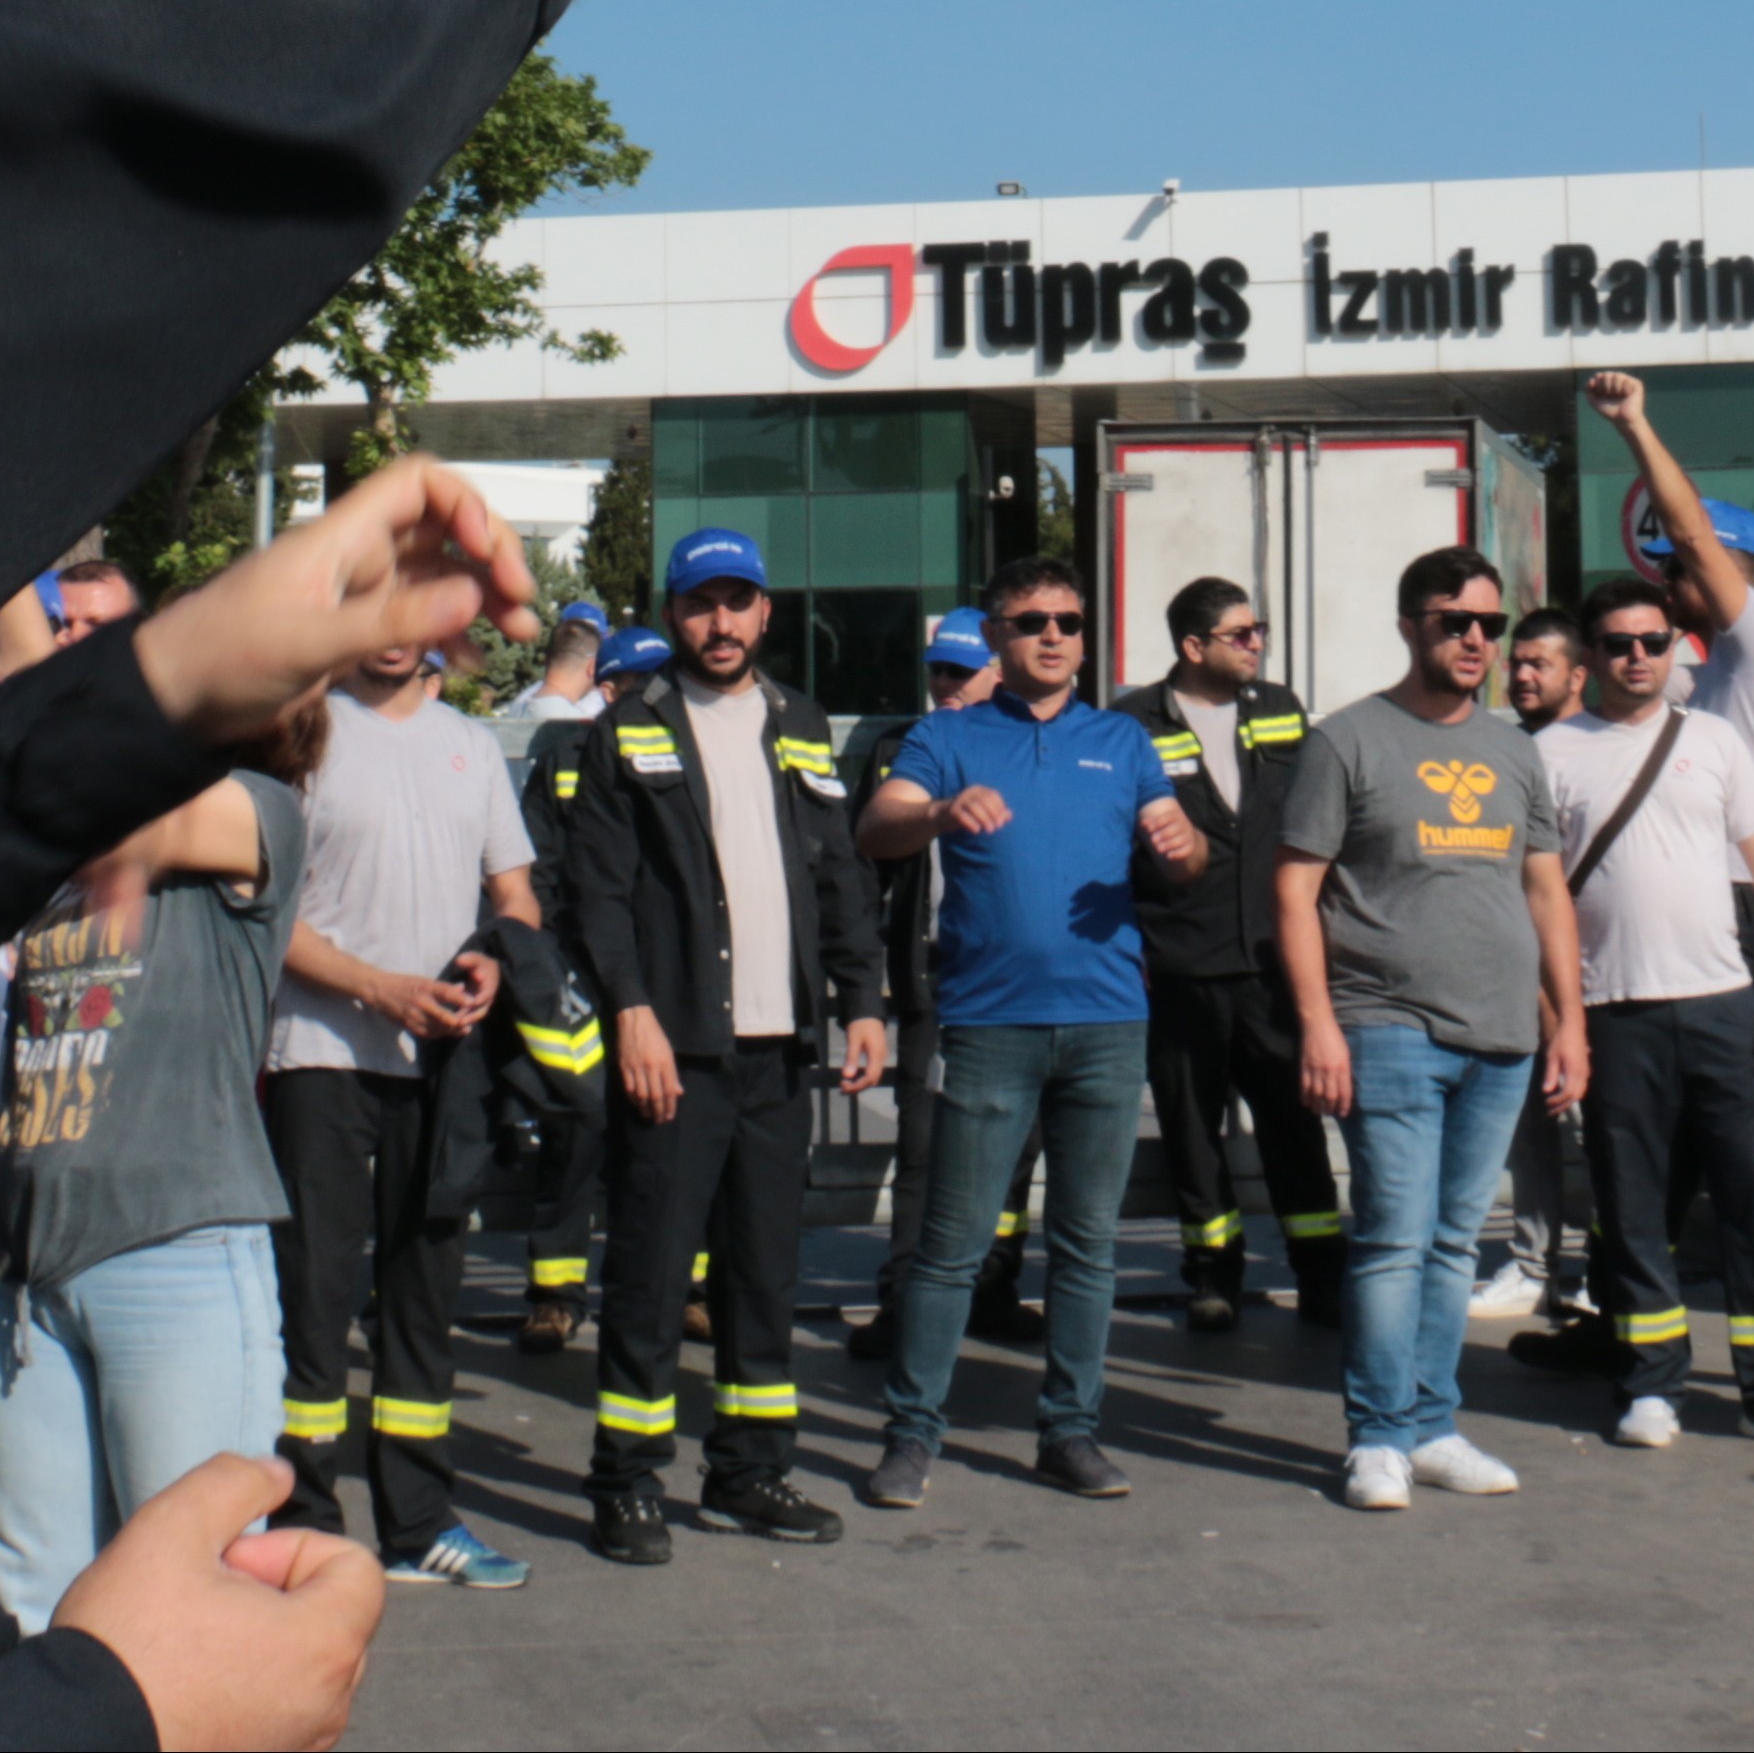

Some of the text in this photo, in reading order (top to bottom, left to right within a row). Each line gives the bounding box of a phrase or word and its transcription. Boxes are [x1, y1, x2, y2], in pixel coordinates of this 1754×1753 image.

[923, 240, 1250, 367] Tüpraş
[1312, 231, 1514, 336] İzmir
[1637, 505, 1660, 541] 4
[1418, 820, 1514, 850] hummel
